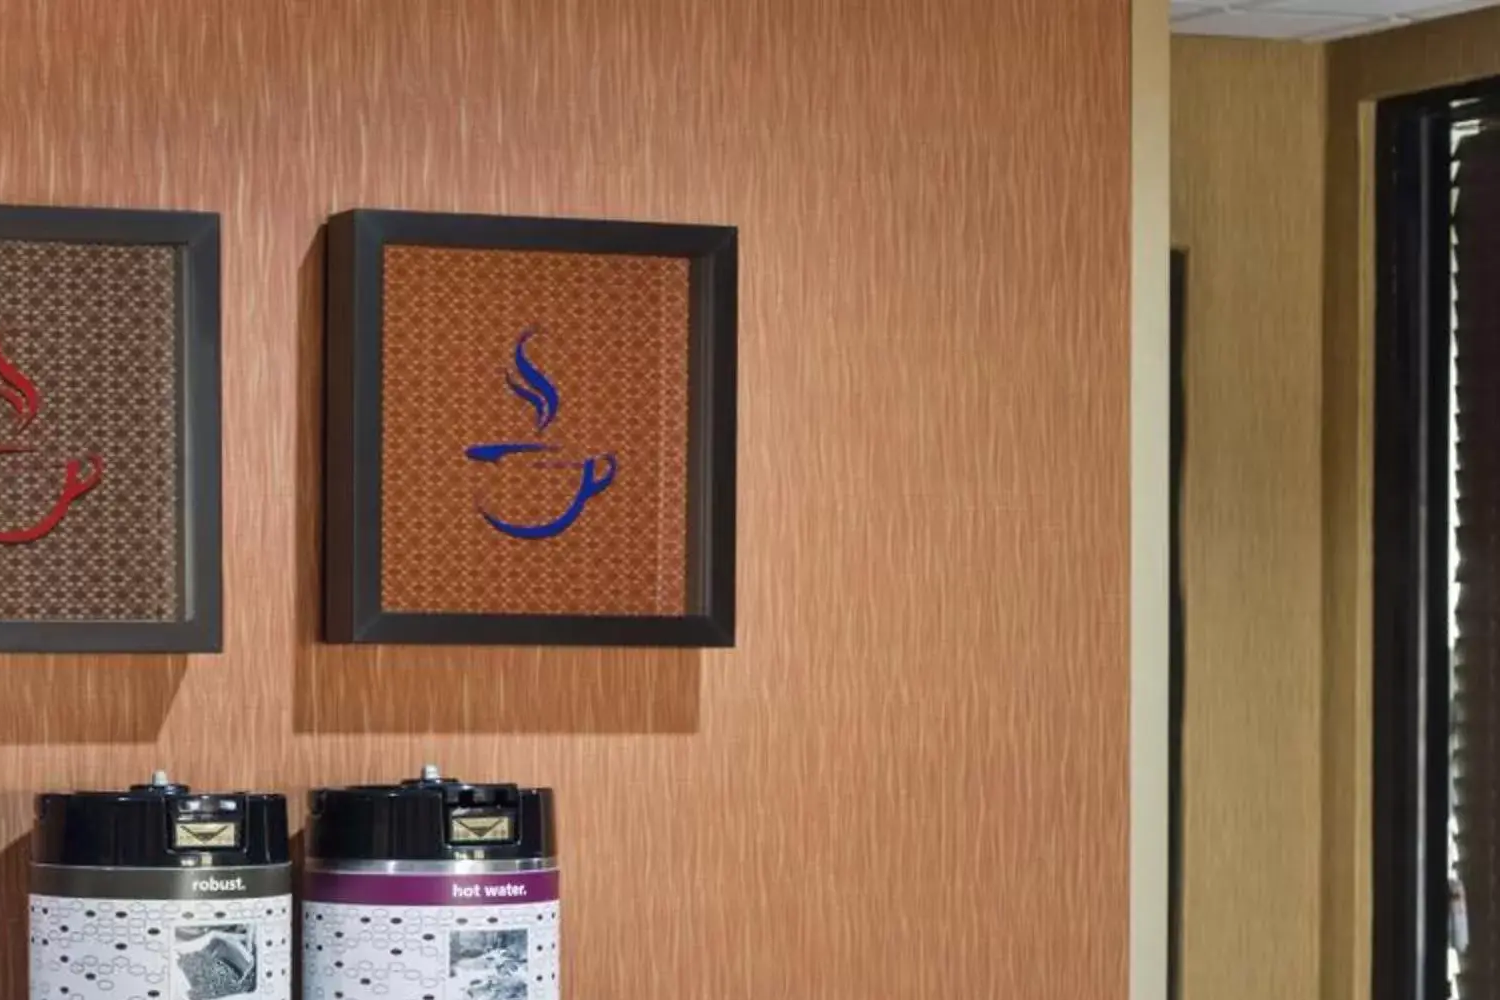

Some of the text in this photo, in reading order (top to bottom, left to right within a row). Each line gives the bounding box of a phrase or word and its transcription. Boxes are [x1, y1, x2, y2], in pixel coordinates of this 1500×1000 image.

[192, 875, 246, 892] robust.
[452, 883, 527, 898] hot water.
